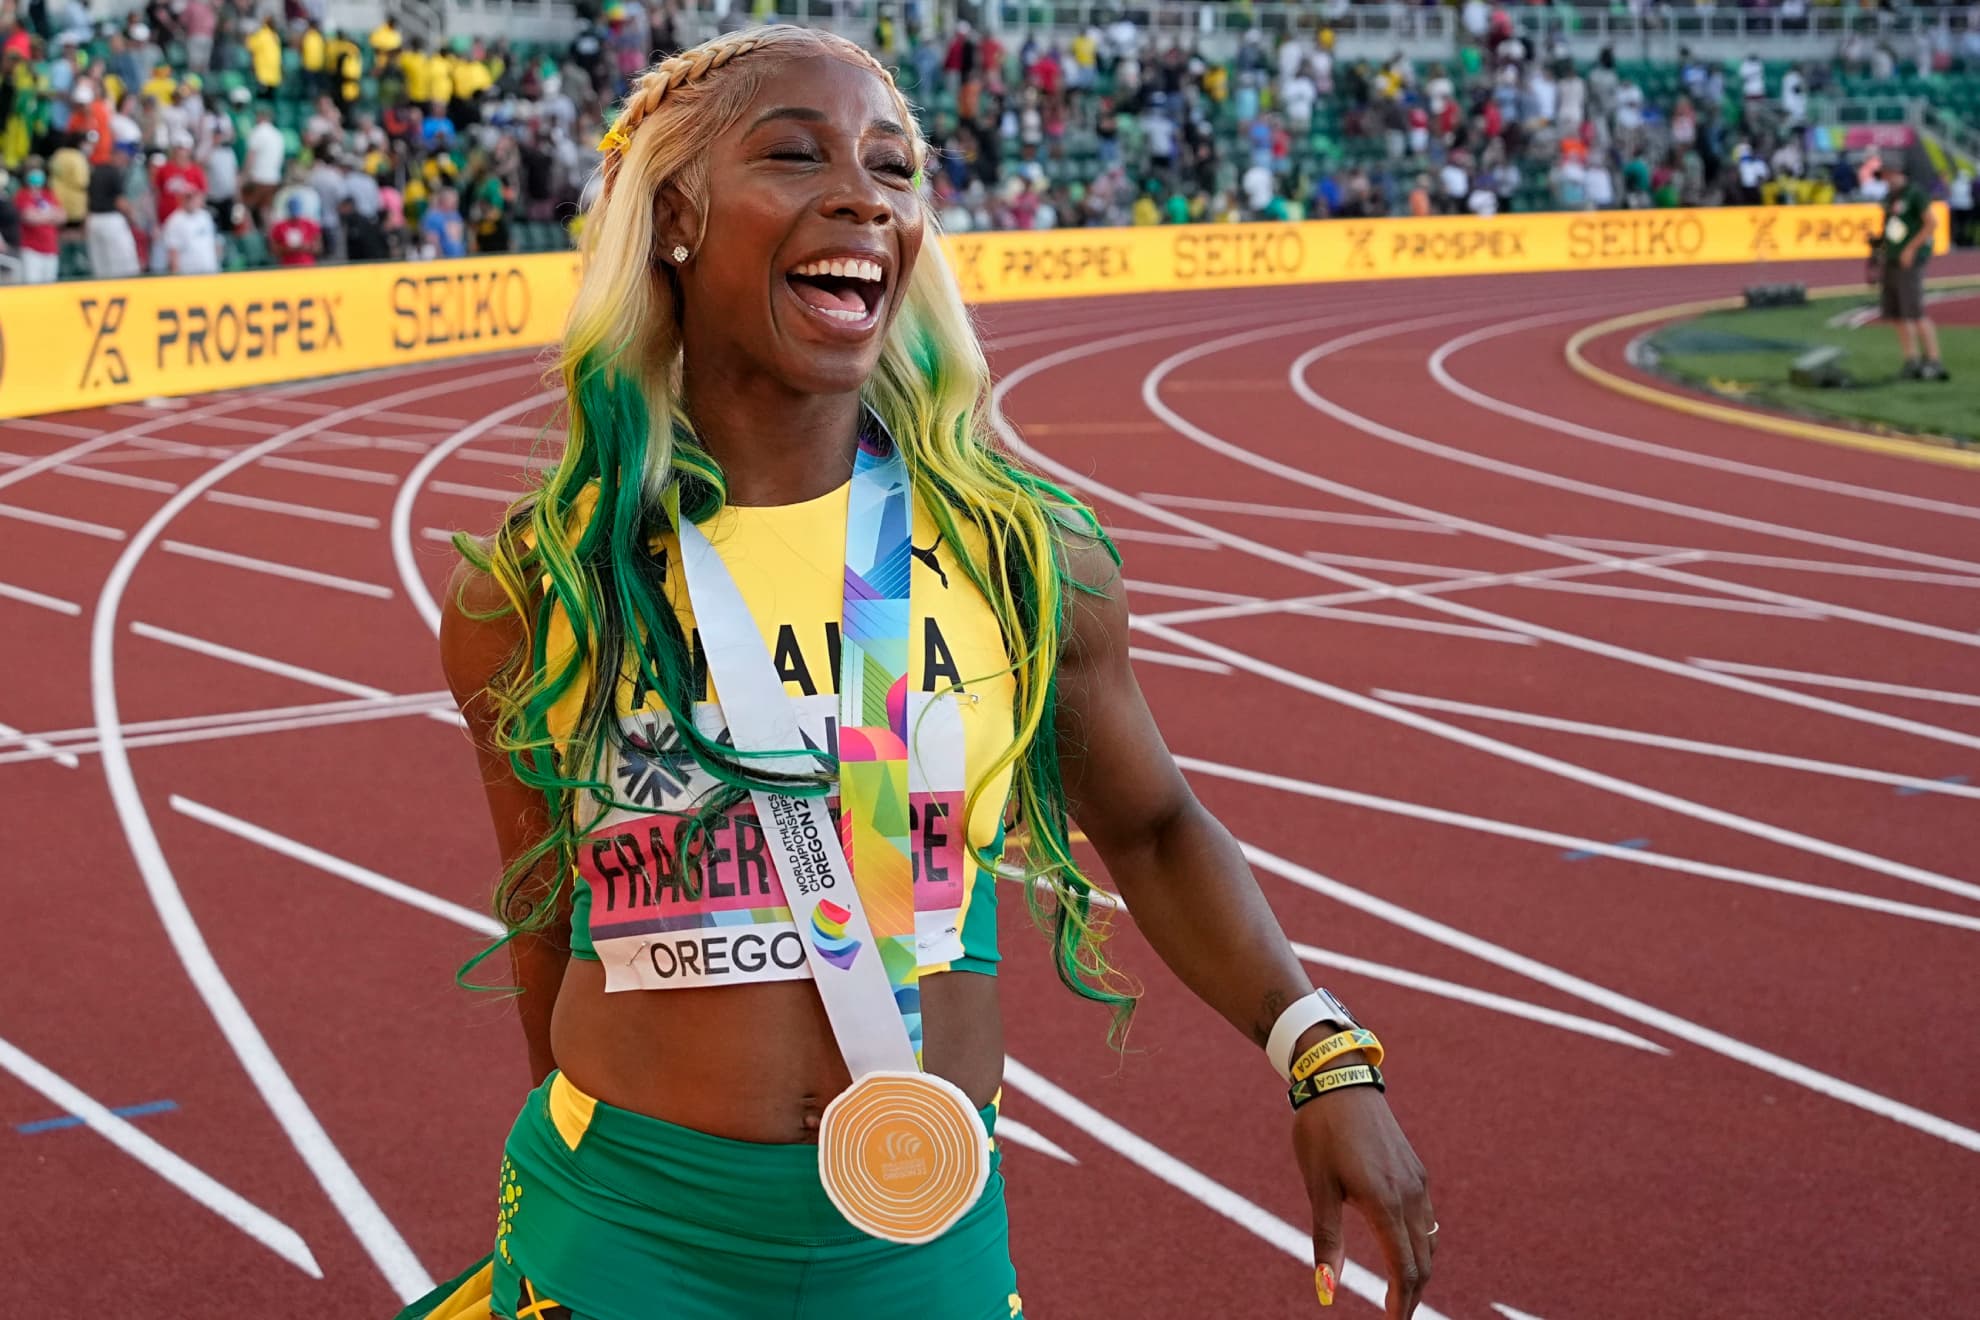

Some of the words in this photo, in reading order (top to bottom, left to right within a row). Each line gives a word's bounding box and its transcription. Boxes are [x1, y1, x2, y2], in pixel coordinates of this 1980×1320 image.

[1393, 228, 1527, 261] PROSPEX
[1568, 216, 1705, 259] SEIKO
[1797, 217, 1874, 244] PROS
[1003, 244, 1132, 282] PROSPEX
[1173, 229, 1305, 279] SEIKO
[392, 267, 531, 349] SEIKO
[157, 292, 342, 368] PROSPEX
[768, 793, 795, 852] ATHLETICS
[789, 855, 809, 896] WORLD
[1297, 1036, 1345, 1073] JAMAICA
[1316, 1068, 1371, 1088] JAMAICA
